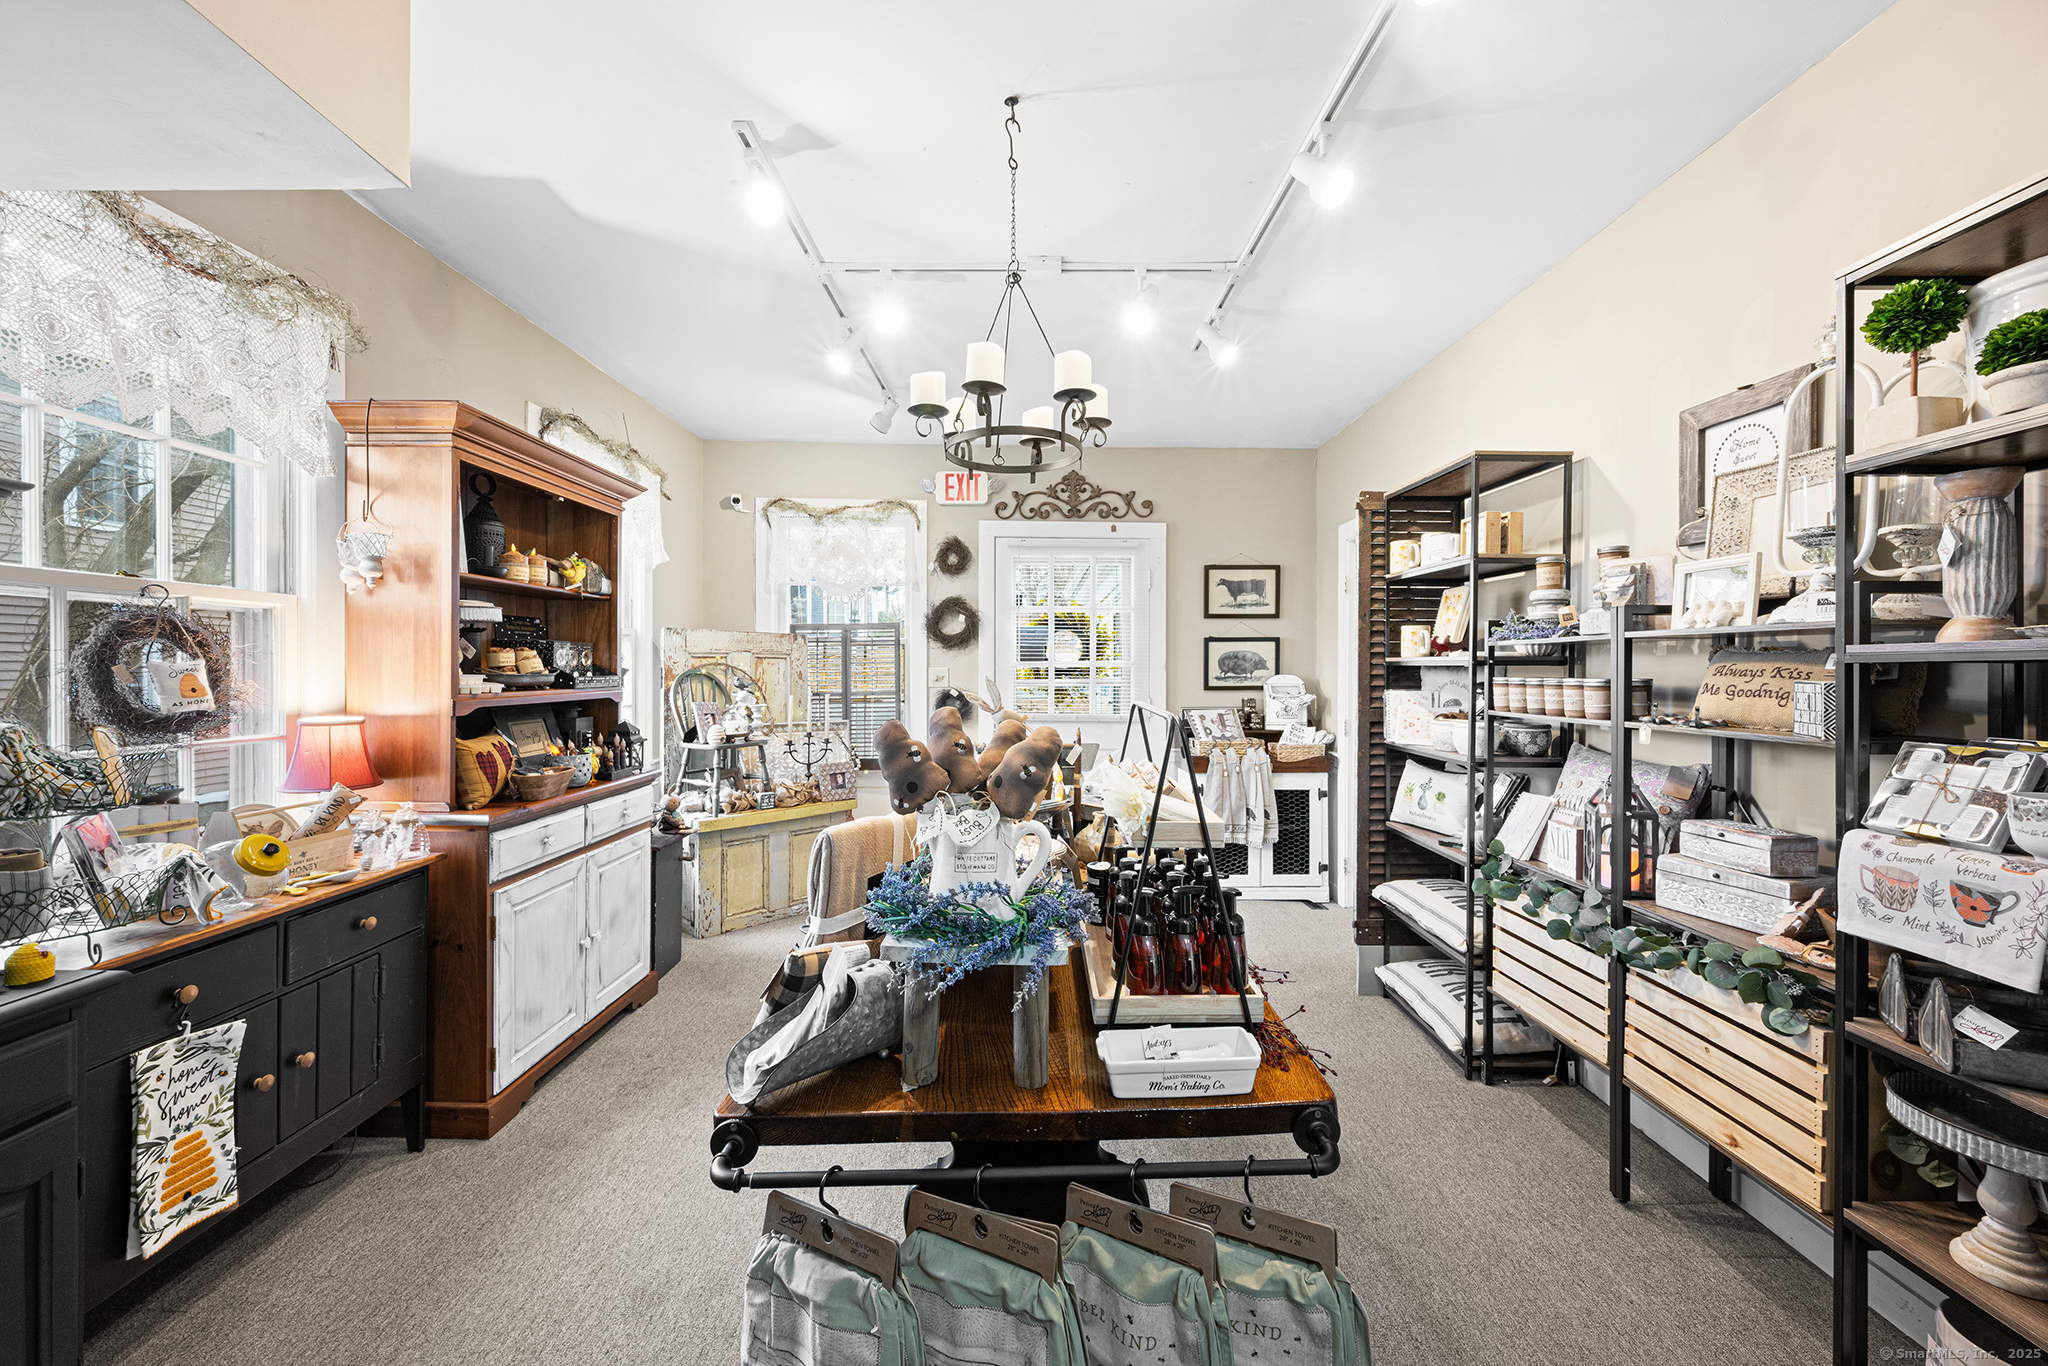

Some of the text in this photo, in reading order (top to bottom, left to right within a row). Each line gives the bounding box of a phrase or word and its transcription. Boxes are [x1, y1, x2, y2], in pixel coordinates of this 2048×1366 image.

[1730, 437, 1761, 453] Home
[1733, 453, 1756, 466] Sweet
[945, 474, 981, 501] EXIT
[169, 664, 199, 679] Sweet
[1712, 663, 1813, 683] Always Kiss
[1701, 683, 1720, 696] Me
[1725, 682, 1792, 708] Goodnig
[314, 796, 345, 826] BE KIND
[953, 815, 970, 828] Bee
[959, 820, 984, 836] Busy
[289, 861, 318, 876] HONEY
[1886, 851, 1936, 866] Chamomile
[1956, 852, 1992, 867] Lemon
[1957, 864, 1996, 882] Verbena
[1902, 915, 1931, 933] Mint
[1976, 925, 2009, 949] Jasmine
[167, 1057, 217, 1089] home
[1149, 1081, 1178, 1091] Mom's
[1180, 1081, 1211, 1093] Baking
[168, 1092, 212, 1128] home
[1153, 1227, 1197, 1247] KITCHEN TOWEL
[1268, 1223, 1316, 1243] KITCHEN TOWEL
[843, 1236, 880, 1256] KITCHEN TOWEL
[999, 1233, 1040, 1254] KITCHEN TOWEL
[1079, 1297, 1157, 1351] BEE KIND
[1229, 1319, 1282, 1341] KIND
